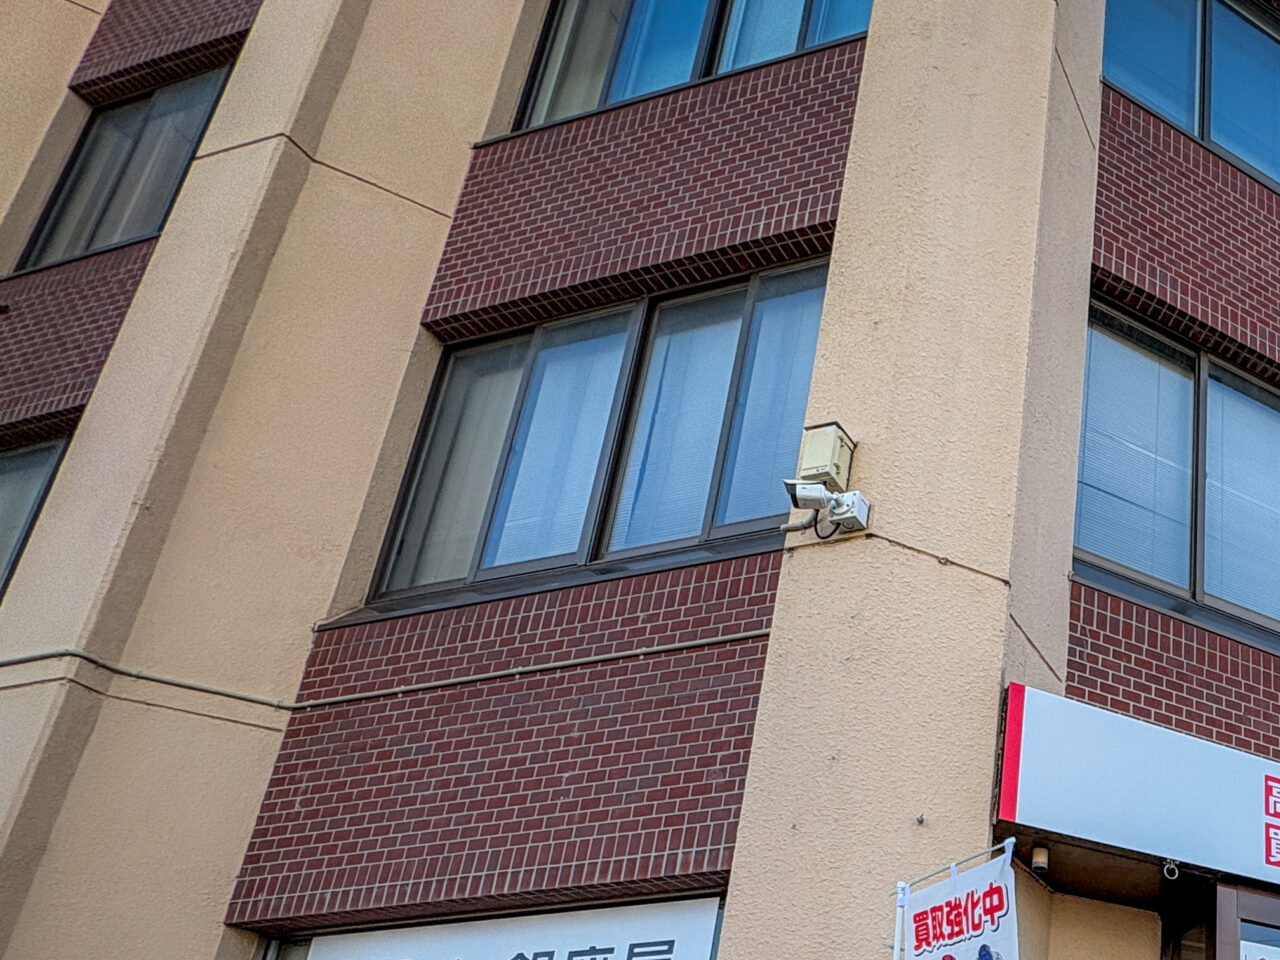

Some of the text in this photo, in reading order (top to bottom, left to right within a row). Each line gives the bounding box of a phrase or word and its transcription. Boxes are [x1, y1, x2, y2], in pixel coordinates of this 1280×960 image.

[913, 883, 1008, 951] 買取強化中
